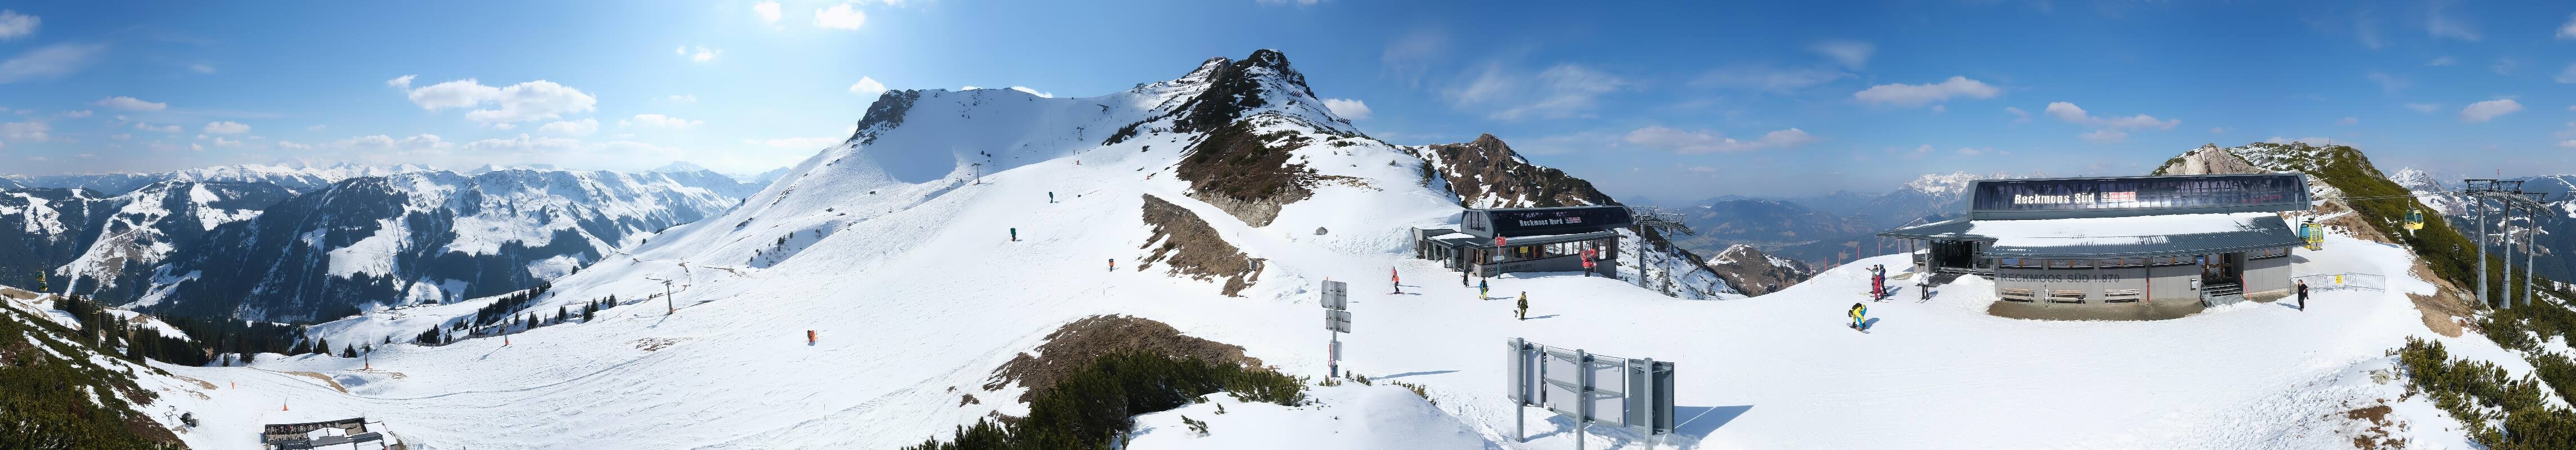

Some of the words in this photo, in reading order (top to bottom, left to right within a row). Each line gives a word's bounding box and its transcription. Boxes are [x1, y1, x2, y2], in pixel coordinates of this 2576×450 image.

[2015, 194, 2070, 204] Reckmoos
[2075, 192, 2094, 204] Süd
[2000, 273, 2062, 282] RECKMOOS
[2067, 273, 2089, 283] SÜD
[2093, 274, 2120, 282] 1.870
